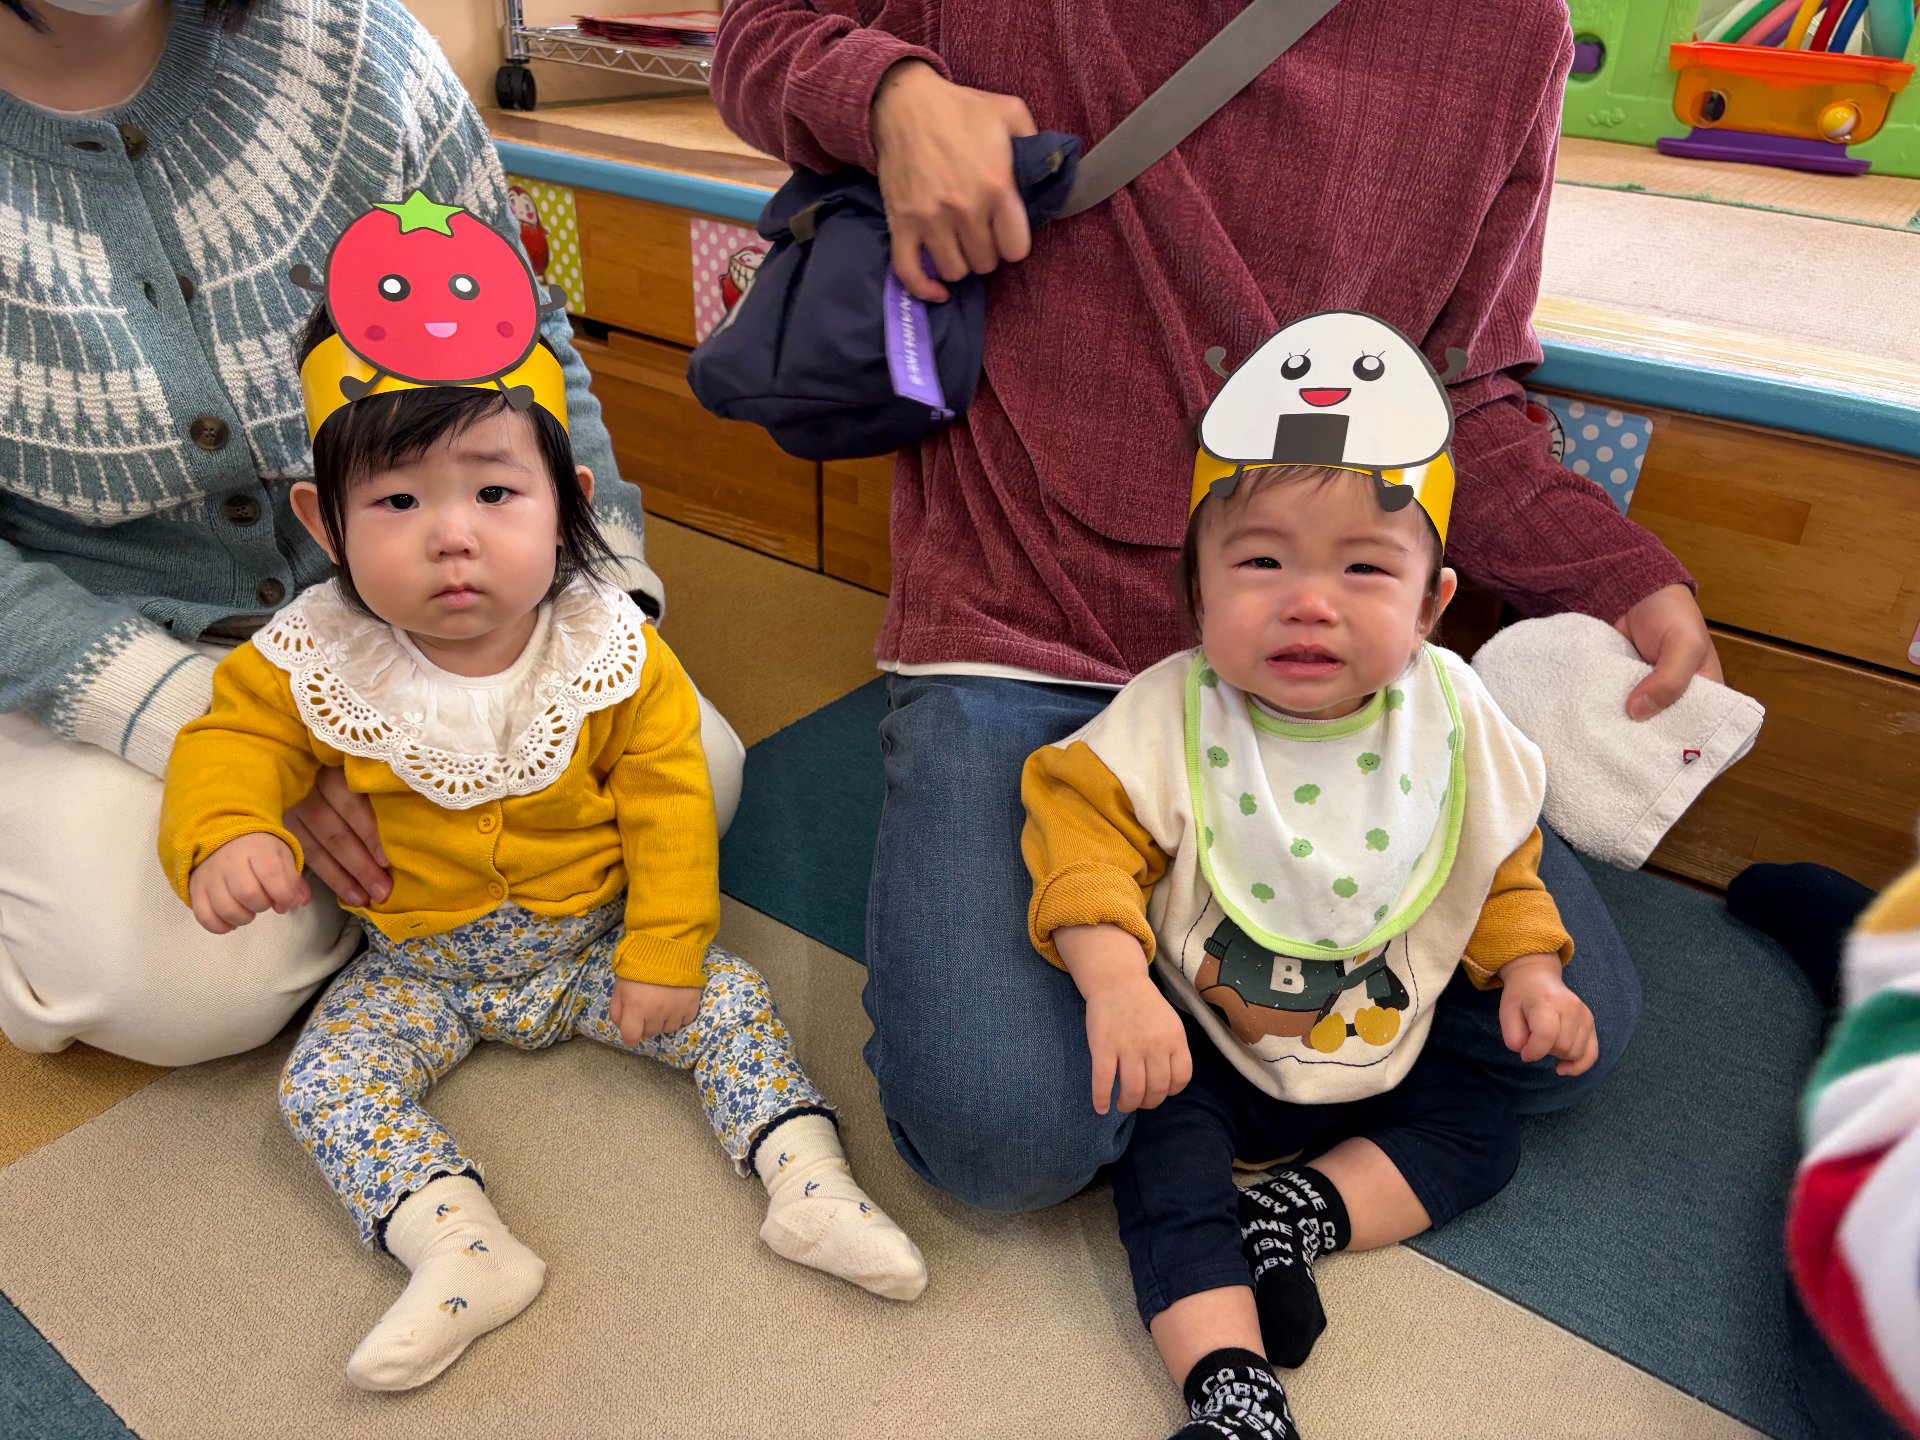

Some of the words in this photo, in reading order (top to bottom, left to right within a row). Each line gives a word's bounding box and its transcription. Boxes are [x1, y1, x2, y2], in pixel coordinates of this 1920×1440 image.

[1270, 956, 1305, 994] B
[1280, 1170, 1328, 1212] OMME
[1253, 1237, 1294, 1257] ISM
[1254, 1256, 1294, 1282] ABY
